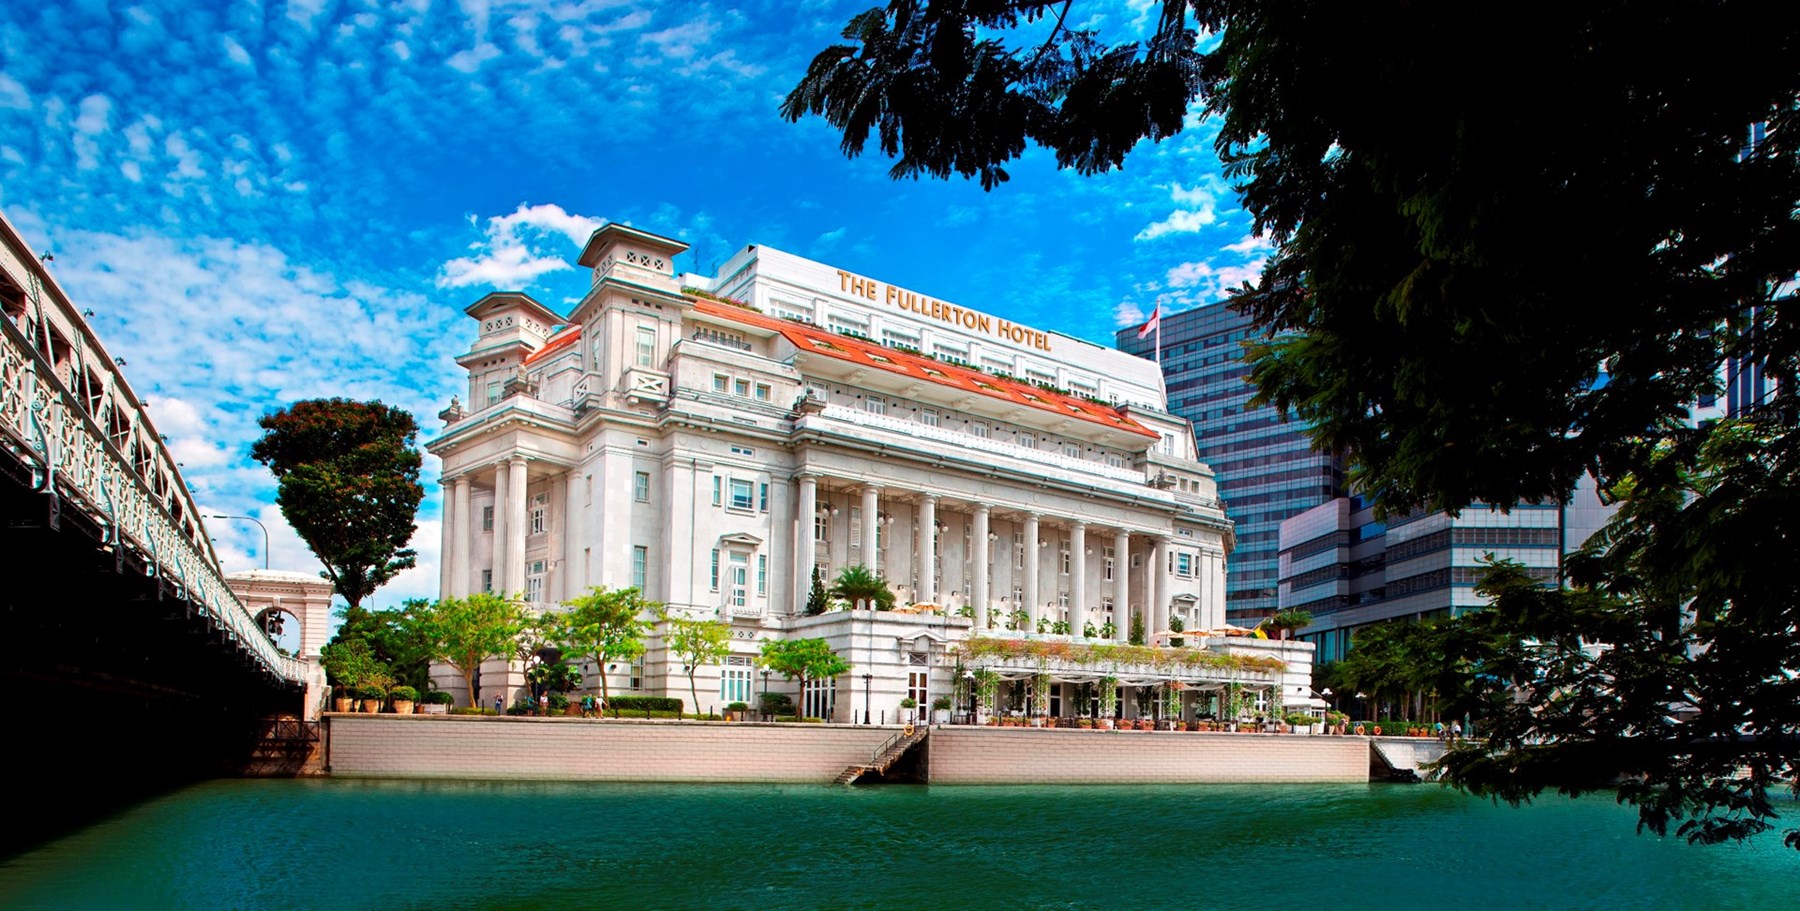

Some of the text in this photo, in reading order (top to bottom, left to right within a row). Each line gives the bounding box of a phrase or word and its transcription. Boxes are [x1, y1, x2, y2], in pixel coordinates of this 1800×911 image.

[837, 270, 1052, 351] THE FULLERTON HOTEL
